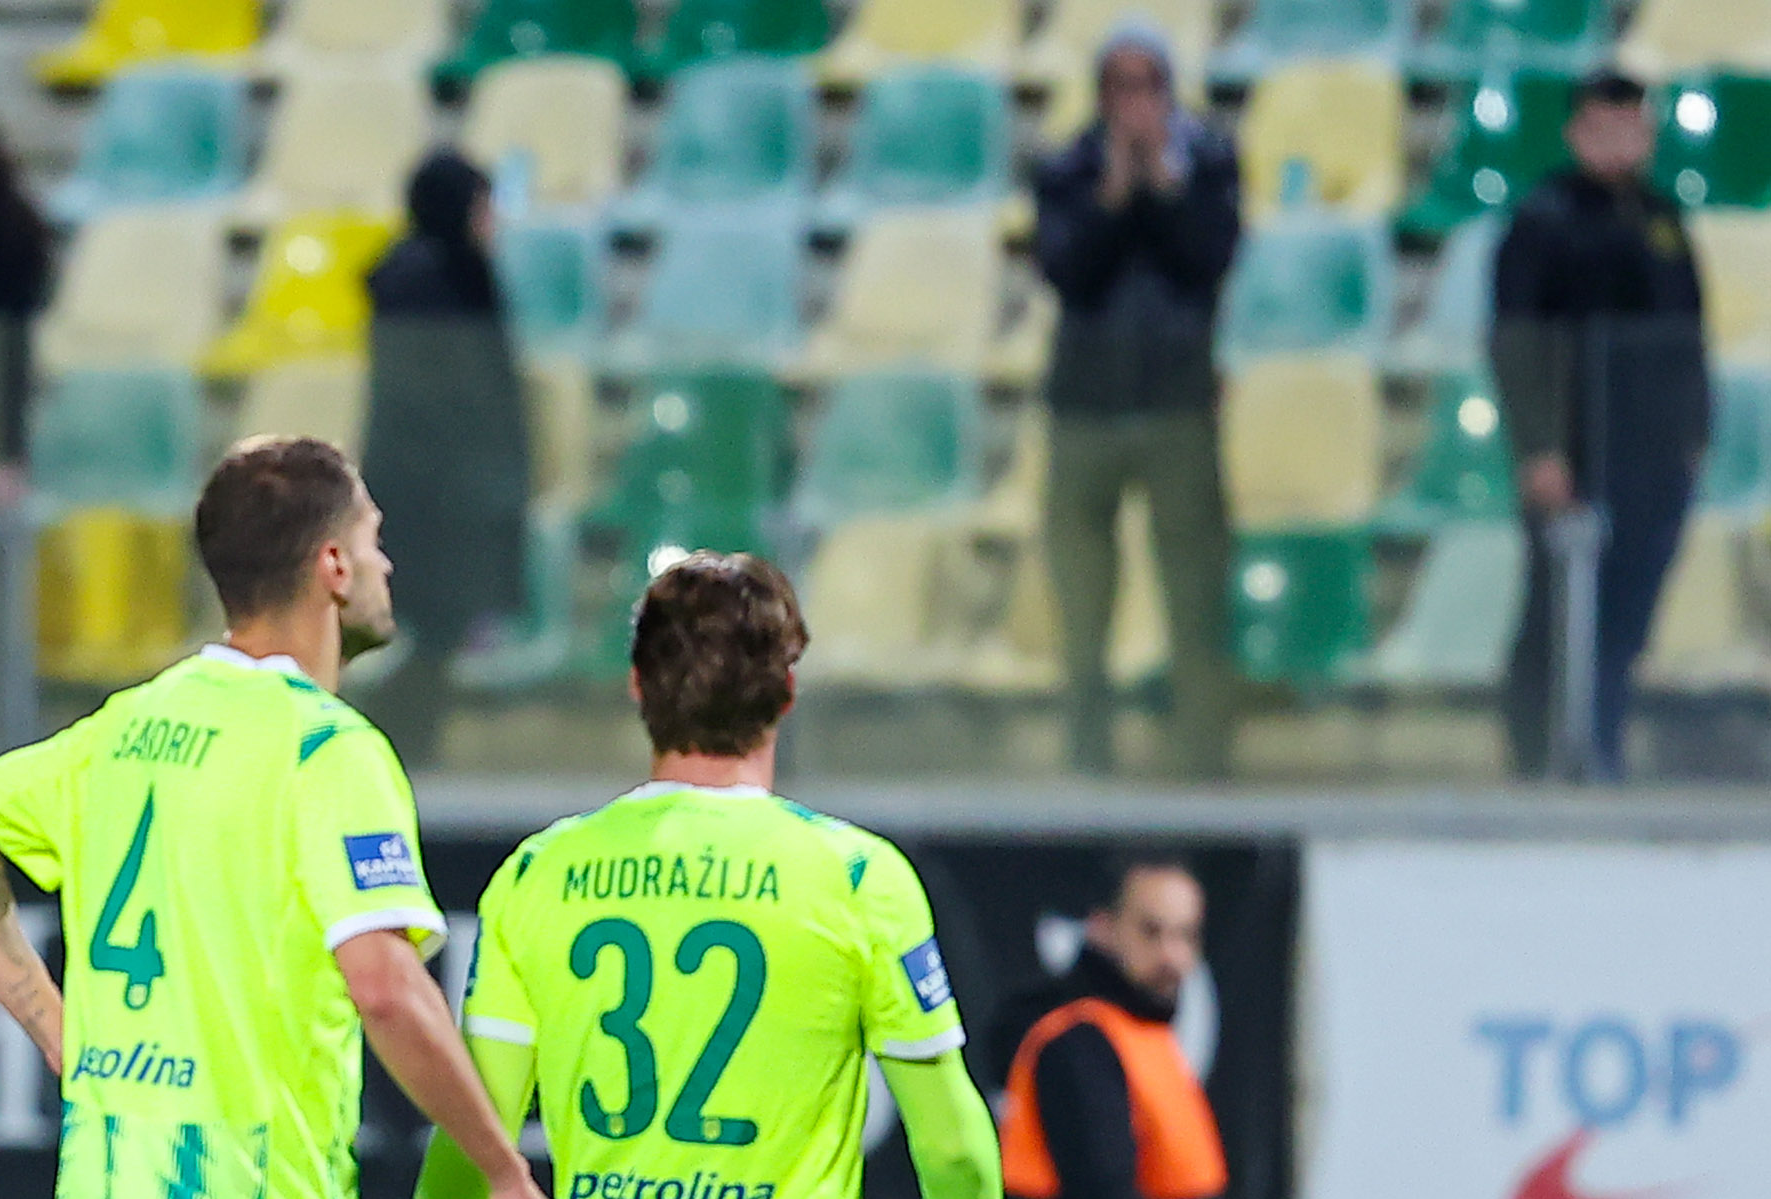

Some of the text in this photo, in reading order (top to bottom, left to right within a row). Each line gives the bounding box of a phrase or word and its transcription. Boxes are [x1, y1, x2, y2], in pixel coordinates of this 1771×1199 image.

[90, 780, 164, 1011] 4
[562, 845, 780, 902] MUDRAŽIJA
[569, 917, 767, 1146] 32
[1471, 1014, 1746, 1128] TOP
